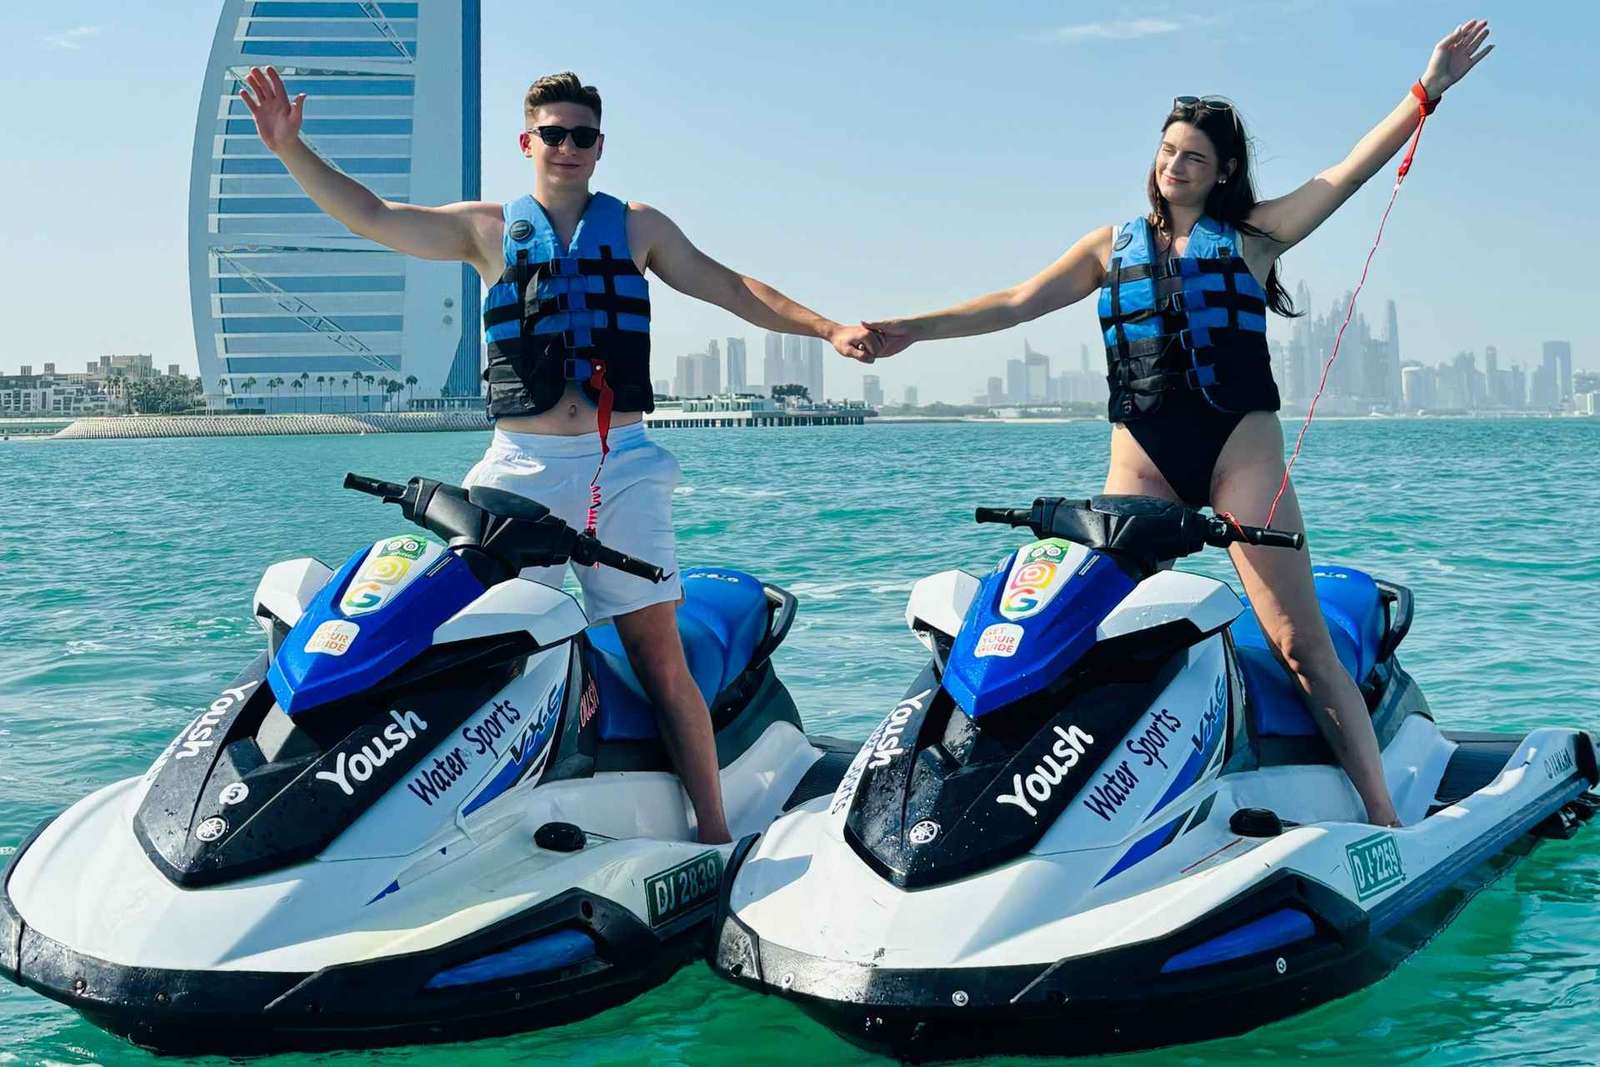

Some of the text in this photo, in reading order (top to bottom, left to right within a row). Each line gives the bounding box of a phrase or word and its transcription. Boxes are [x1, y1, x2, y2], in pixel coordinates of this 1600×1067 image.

[175, 680, 259, 760] Yoush
[315, 710, 428, 796] Yoush
[407, 699, 521, 806] Water Sports
[868, 688, 932, 770] Yoush
[996, 724, 1094, 817] Yoush
[1083, 708, 1182, 822] Water Sports
[655, 858, 718, 916] DJ 2839
[1371, 840, 1399, 881] 2259
